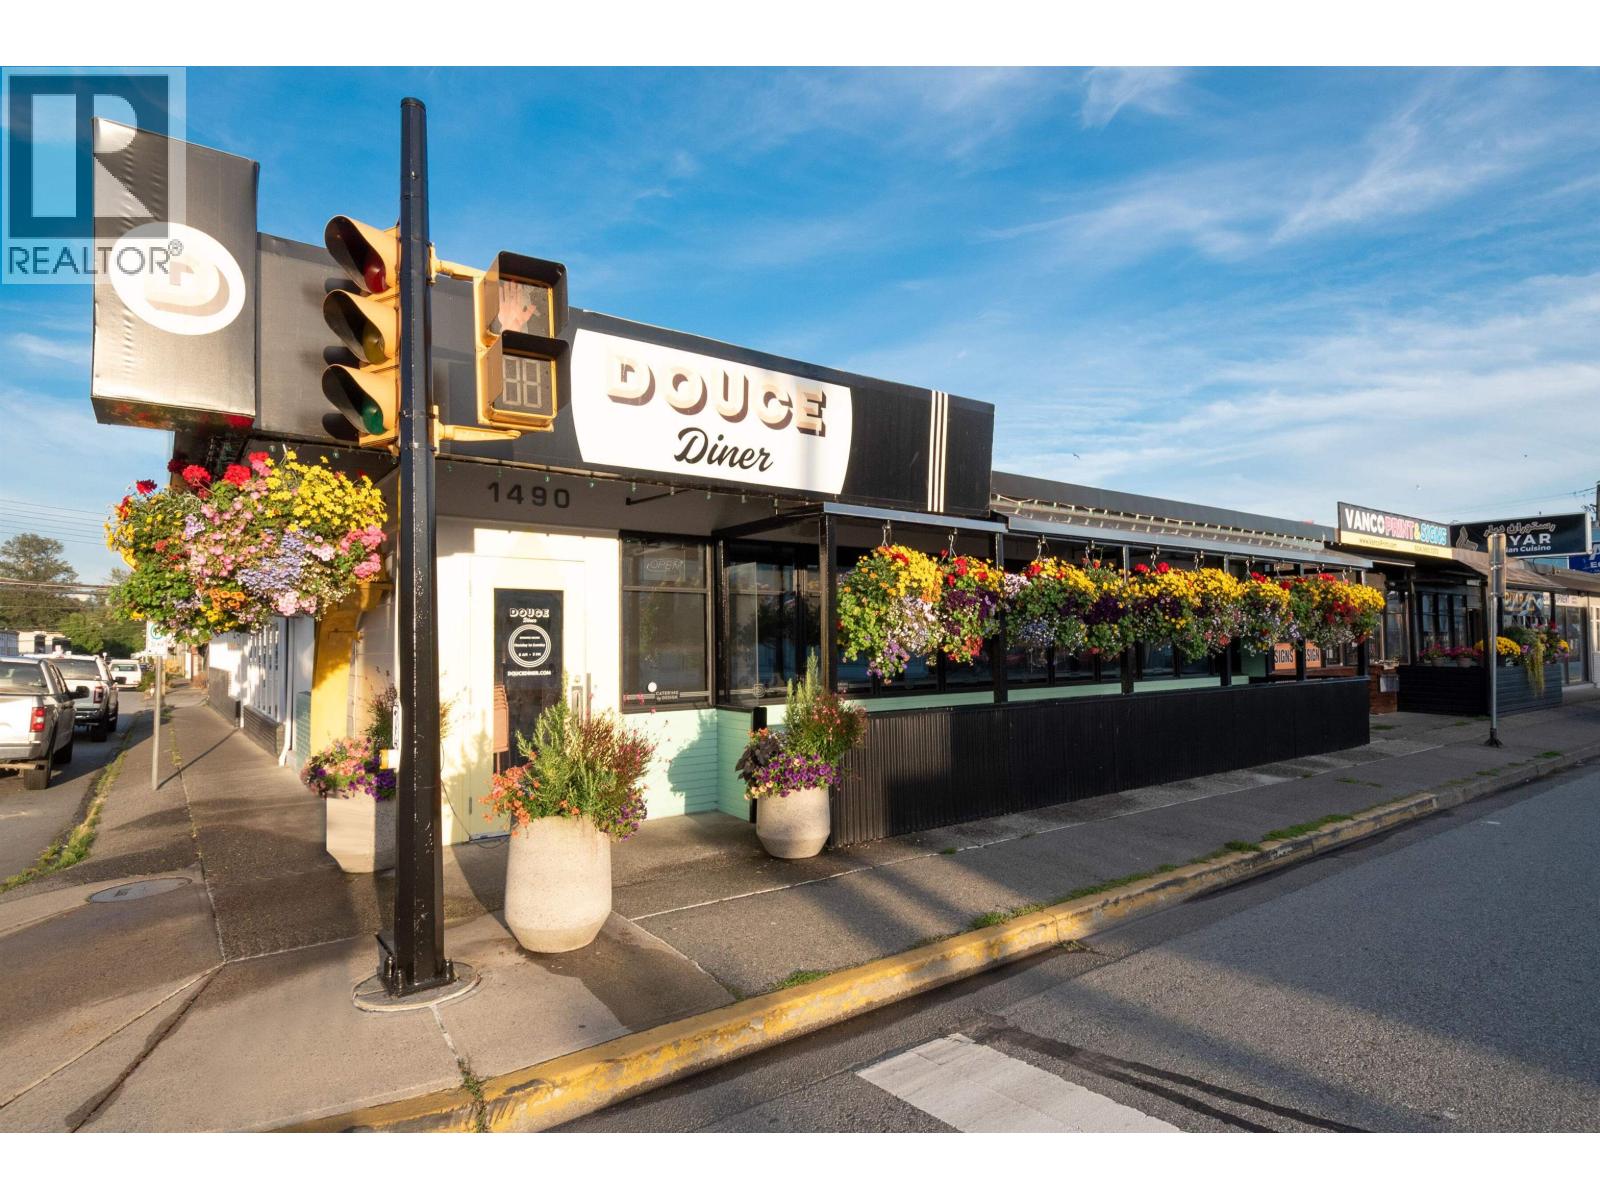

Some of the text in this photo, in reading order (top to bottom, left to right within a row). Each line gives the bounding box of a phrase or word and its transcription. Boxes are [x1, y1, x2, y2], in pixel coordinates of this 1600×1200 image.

[607, 354, 827, 437] DOUCE
[674, 427, 773, 472] Diner
[487, 482, 570, 508] 1490
[1509, 533, 1552, 546] YAR
[1520, 544, 1552, 552] Cuisine
[510, 608, 549, 617] DOUCE
[1274, 650, 1294, 664] SIGNS
[1306, 649, 1320, 662] SIGN
